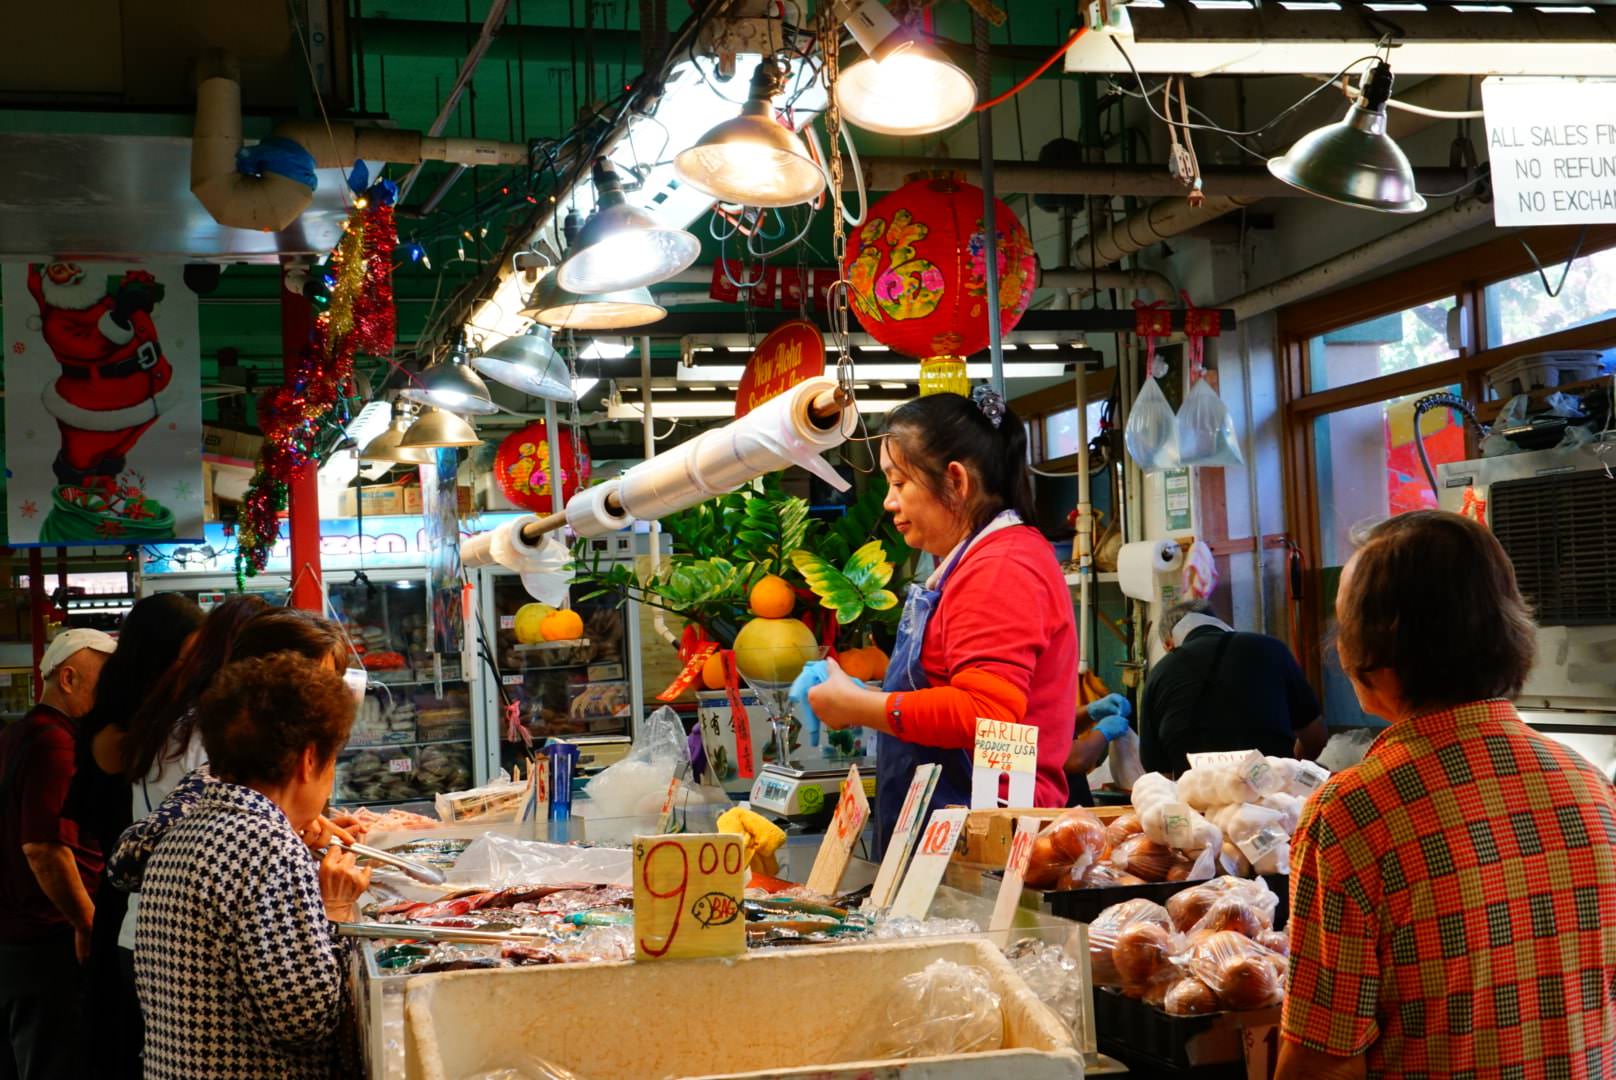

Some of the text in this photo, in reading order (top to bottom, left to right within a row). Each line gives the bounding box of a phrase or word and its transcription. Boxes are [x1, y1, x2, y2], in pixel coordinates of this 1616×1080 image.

[1491, 127, 1525, 147] ALL
[1530, 124, 1588, 146] SALES
[1515, 157, 1616, 179] NO REFUN
[1518, 189, 1616, 213] NO EXCHA
[976, 719, 1036, 745] GARLIC
[1014, 744, 1036, 757] USA
